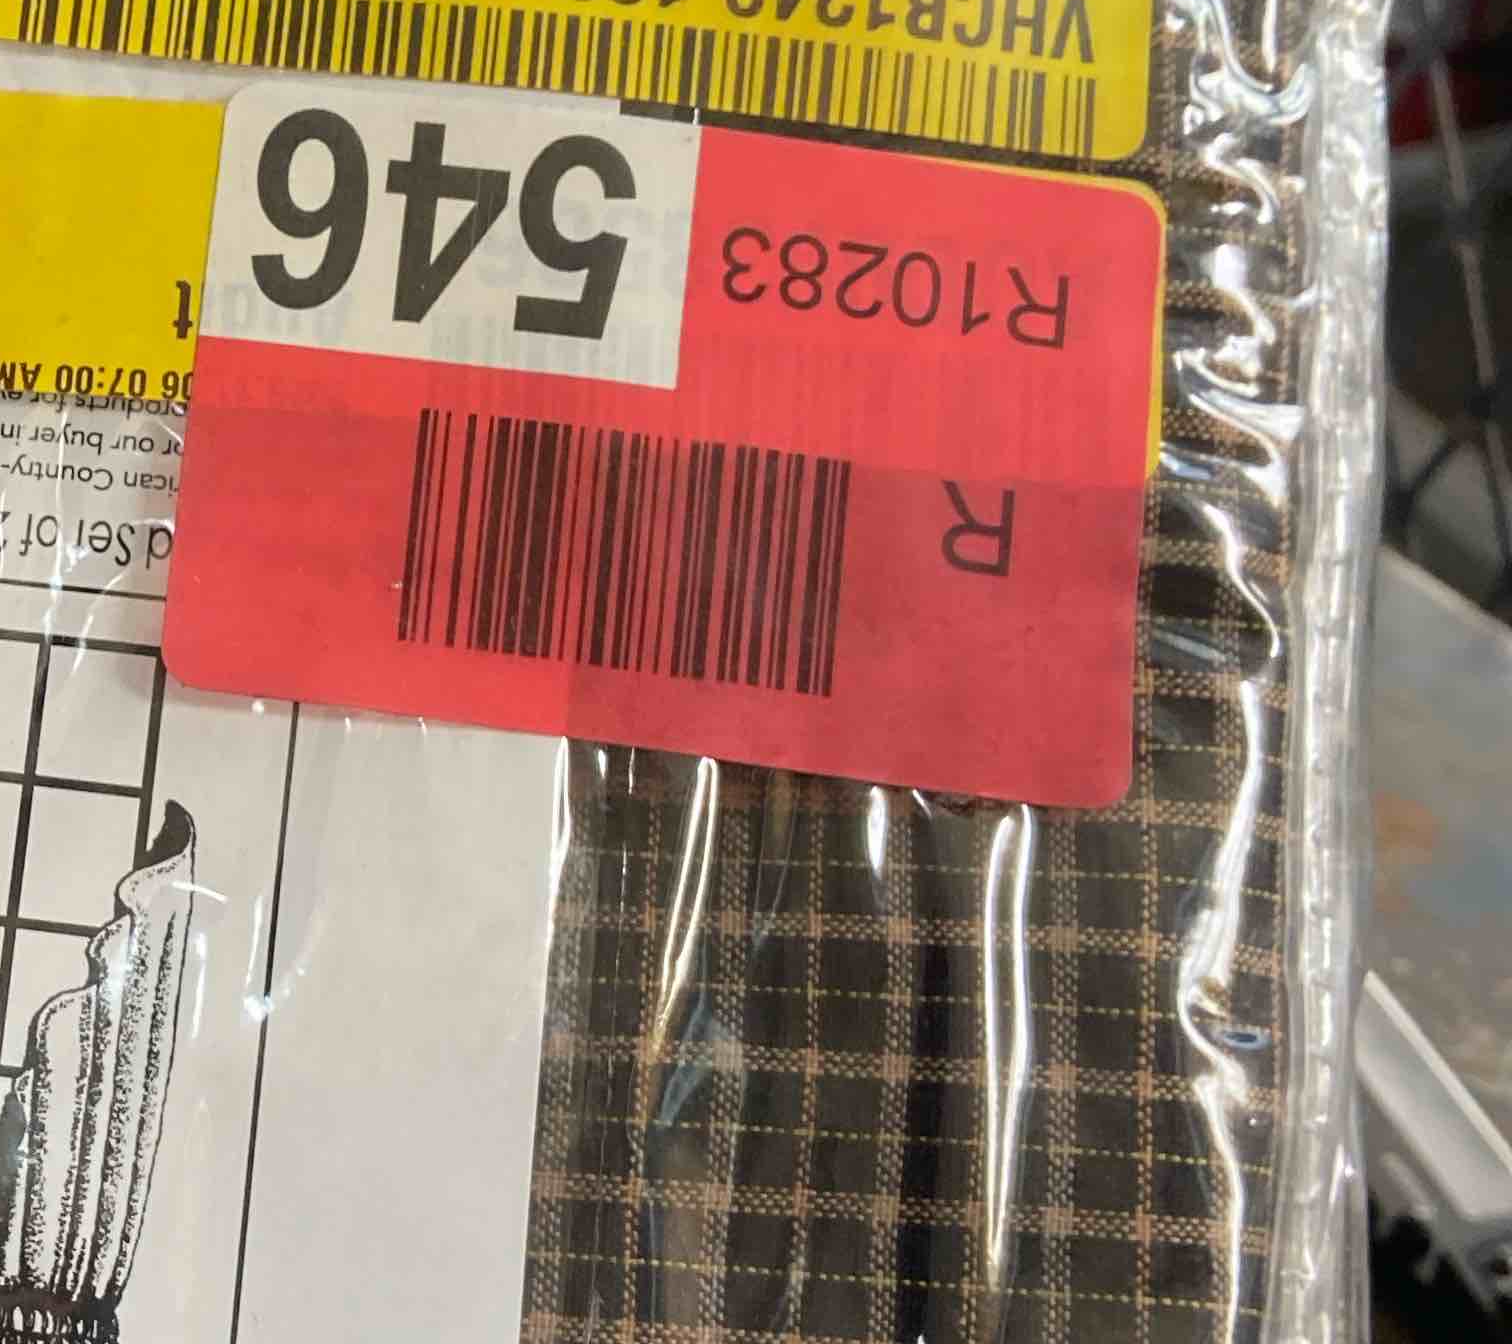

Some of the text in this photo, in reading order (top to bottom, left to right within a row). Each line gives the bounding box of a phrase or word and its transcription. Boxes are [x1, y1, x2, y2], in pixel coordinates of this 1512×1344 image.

[250, 106, 635, 339] 546
[721, 225, 1069, 348] R10283
[54, 364, 147, 400] 07:00
[0, 422, 21, 445] in
[28, 421, 103, 455] buyer
[109, 434, 155, 453] our
[17, 512, 58, 556] of
[940, 479, 1015, 576] R
